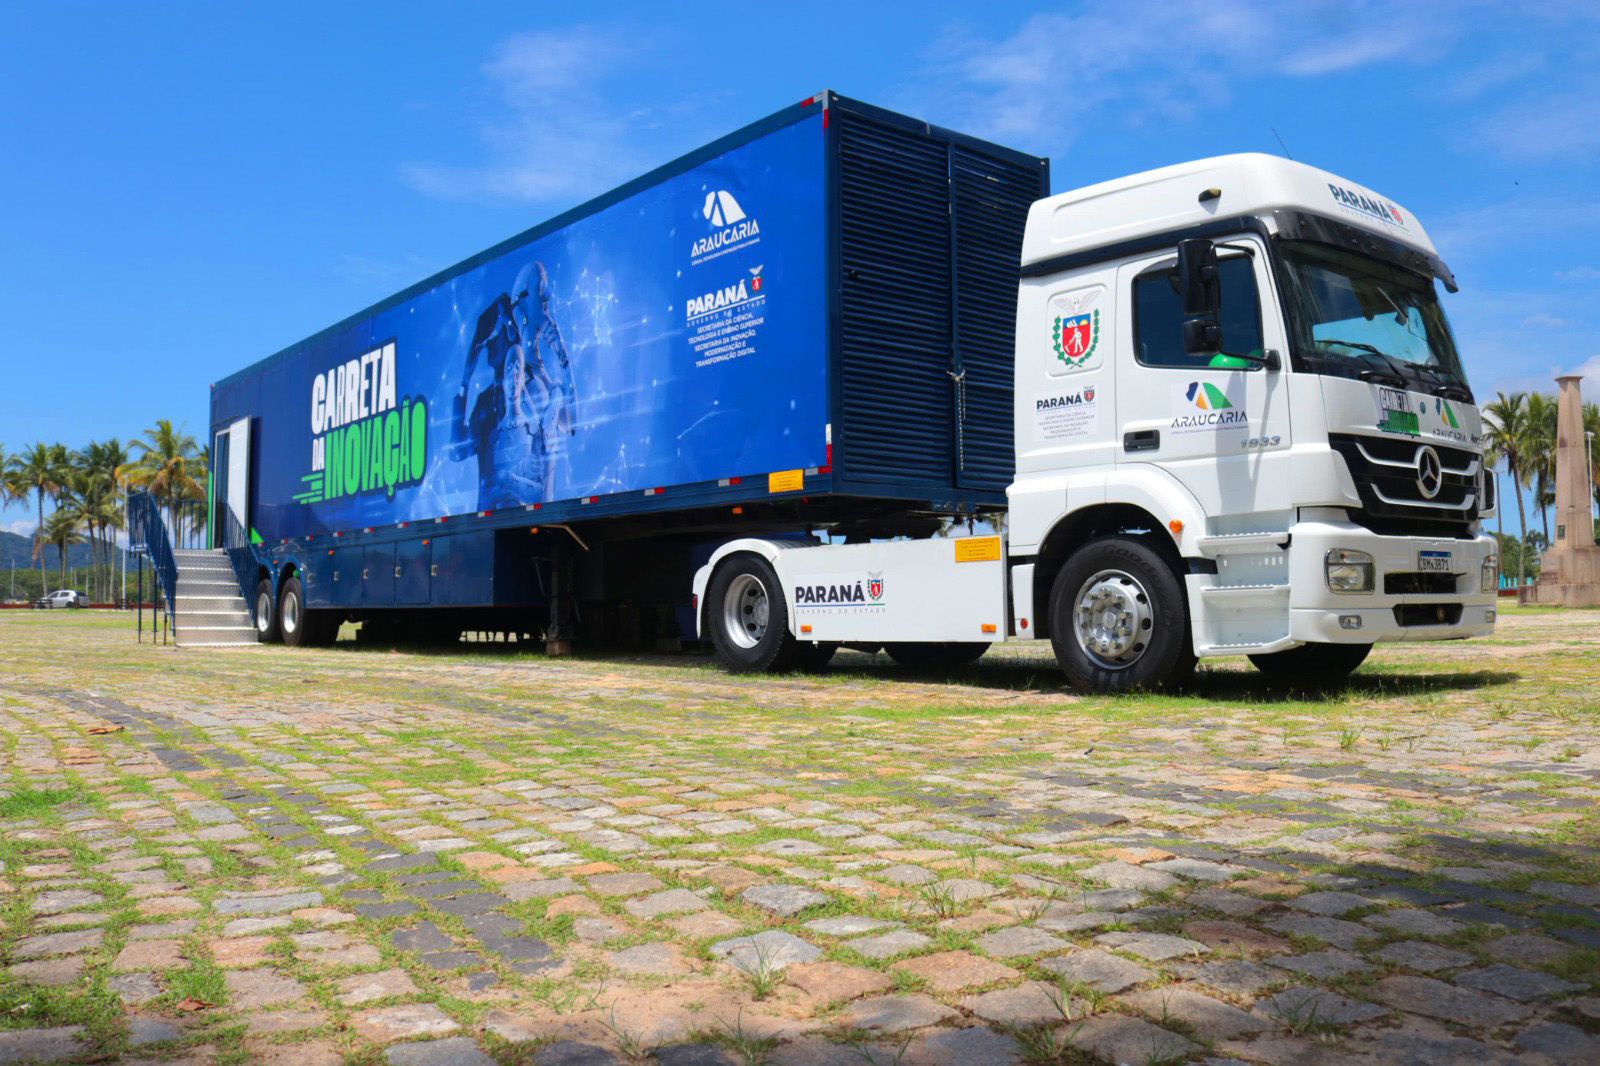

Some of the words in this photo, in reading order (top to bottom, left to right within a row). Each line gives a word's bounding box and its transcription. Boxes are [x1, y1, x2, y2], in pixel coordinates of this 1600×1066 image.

[1327, 183, 1393, 221] PARANÁ
[691, 219, 759, 257] ARAUCARIA
[687, 279, 748, 317] PARANÁ
[311, 342, 396, 435] CARRETA
[1036, 391, 1082, 410] PARANÁ
[1171, 410, 1248, 428] ARAUCARIA
[311, 436, 325, 472] DA
[324, 399, 426, 500] INOVAÇÃO
[1241, 435, 1281, 448] 1933
[795, 581, 865, 603] PARANÁ
